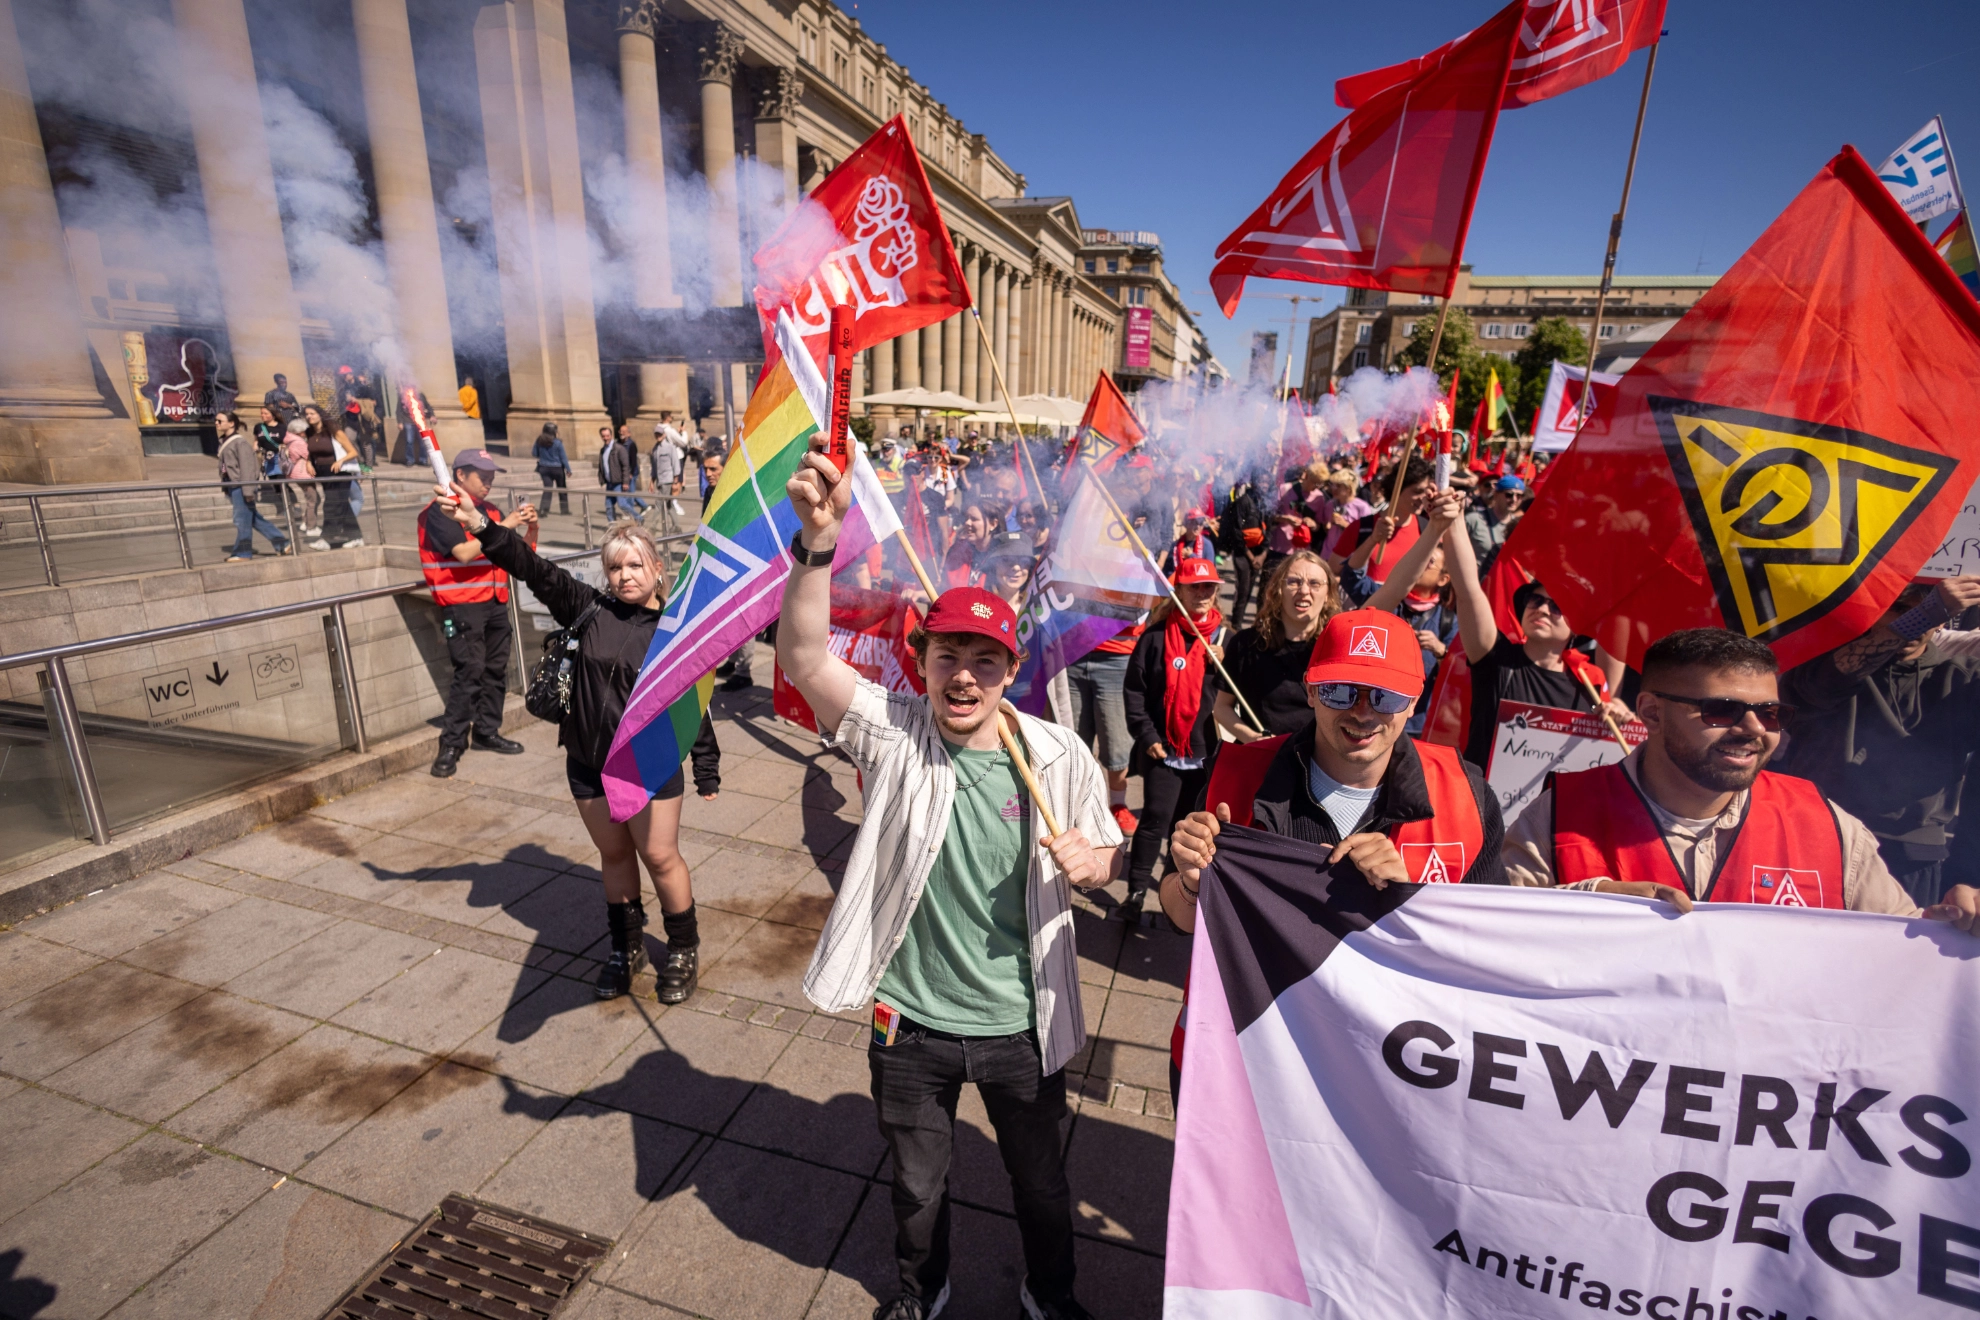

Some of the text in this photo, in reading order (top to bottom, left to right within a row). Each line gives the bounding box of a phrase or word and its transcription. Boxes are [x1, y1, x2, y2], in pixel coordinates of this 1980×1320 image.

[149, 680, 190, 703] WC
[152, 701, 240, 728] in der Unterführung
[1541, 720, 1648, 742] STATT EURE PRFITE!
[1381, 1019, 1972, 1180] GEWERKS
[1645, 1170, 1980, 1312] GEGE
